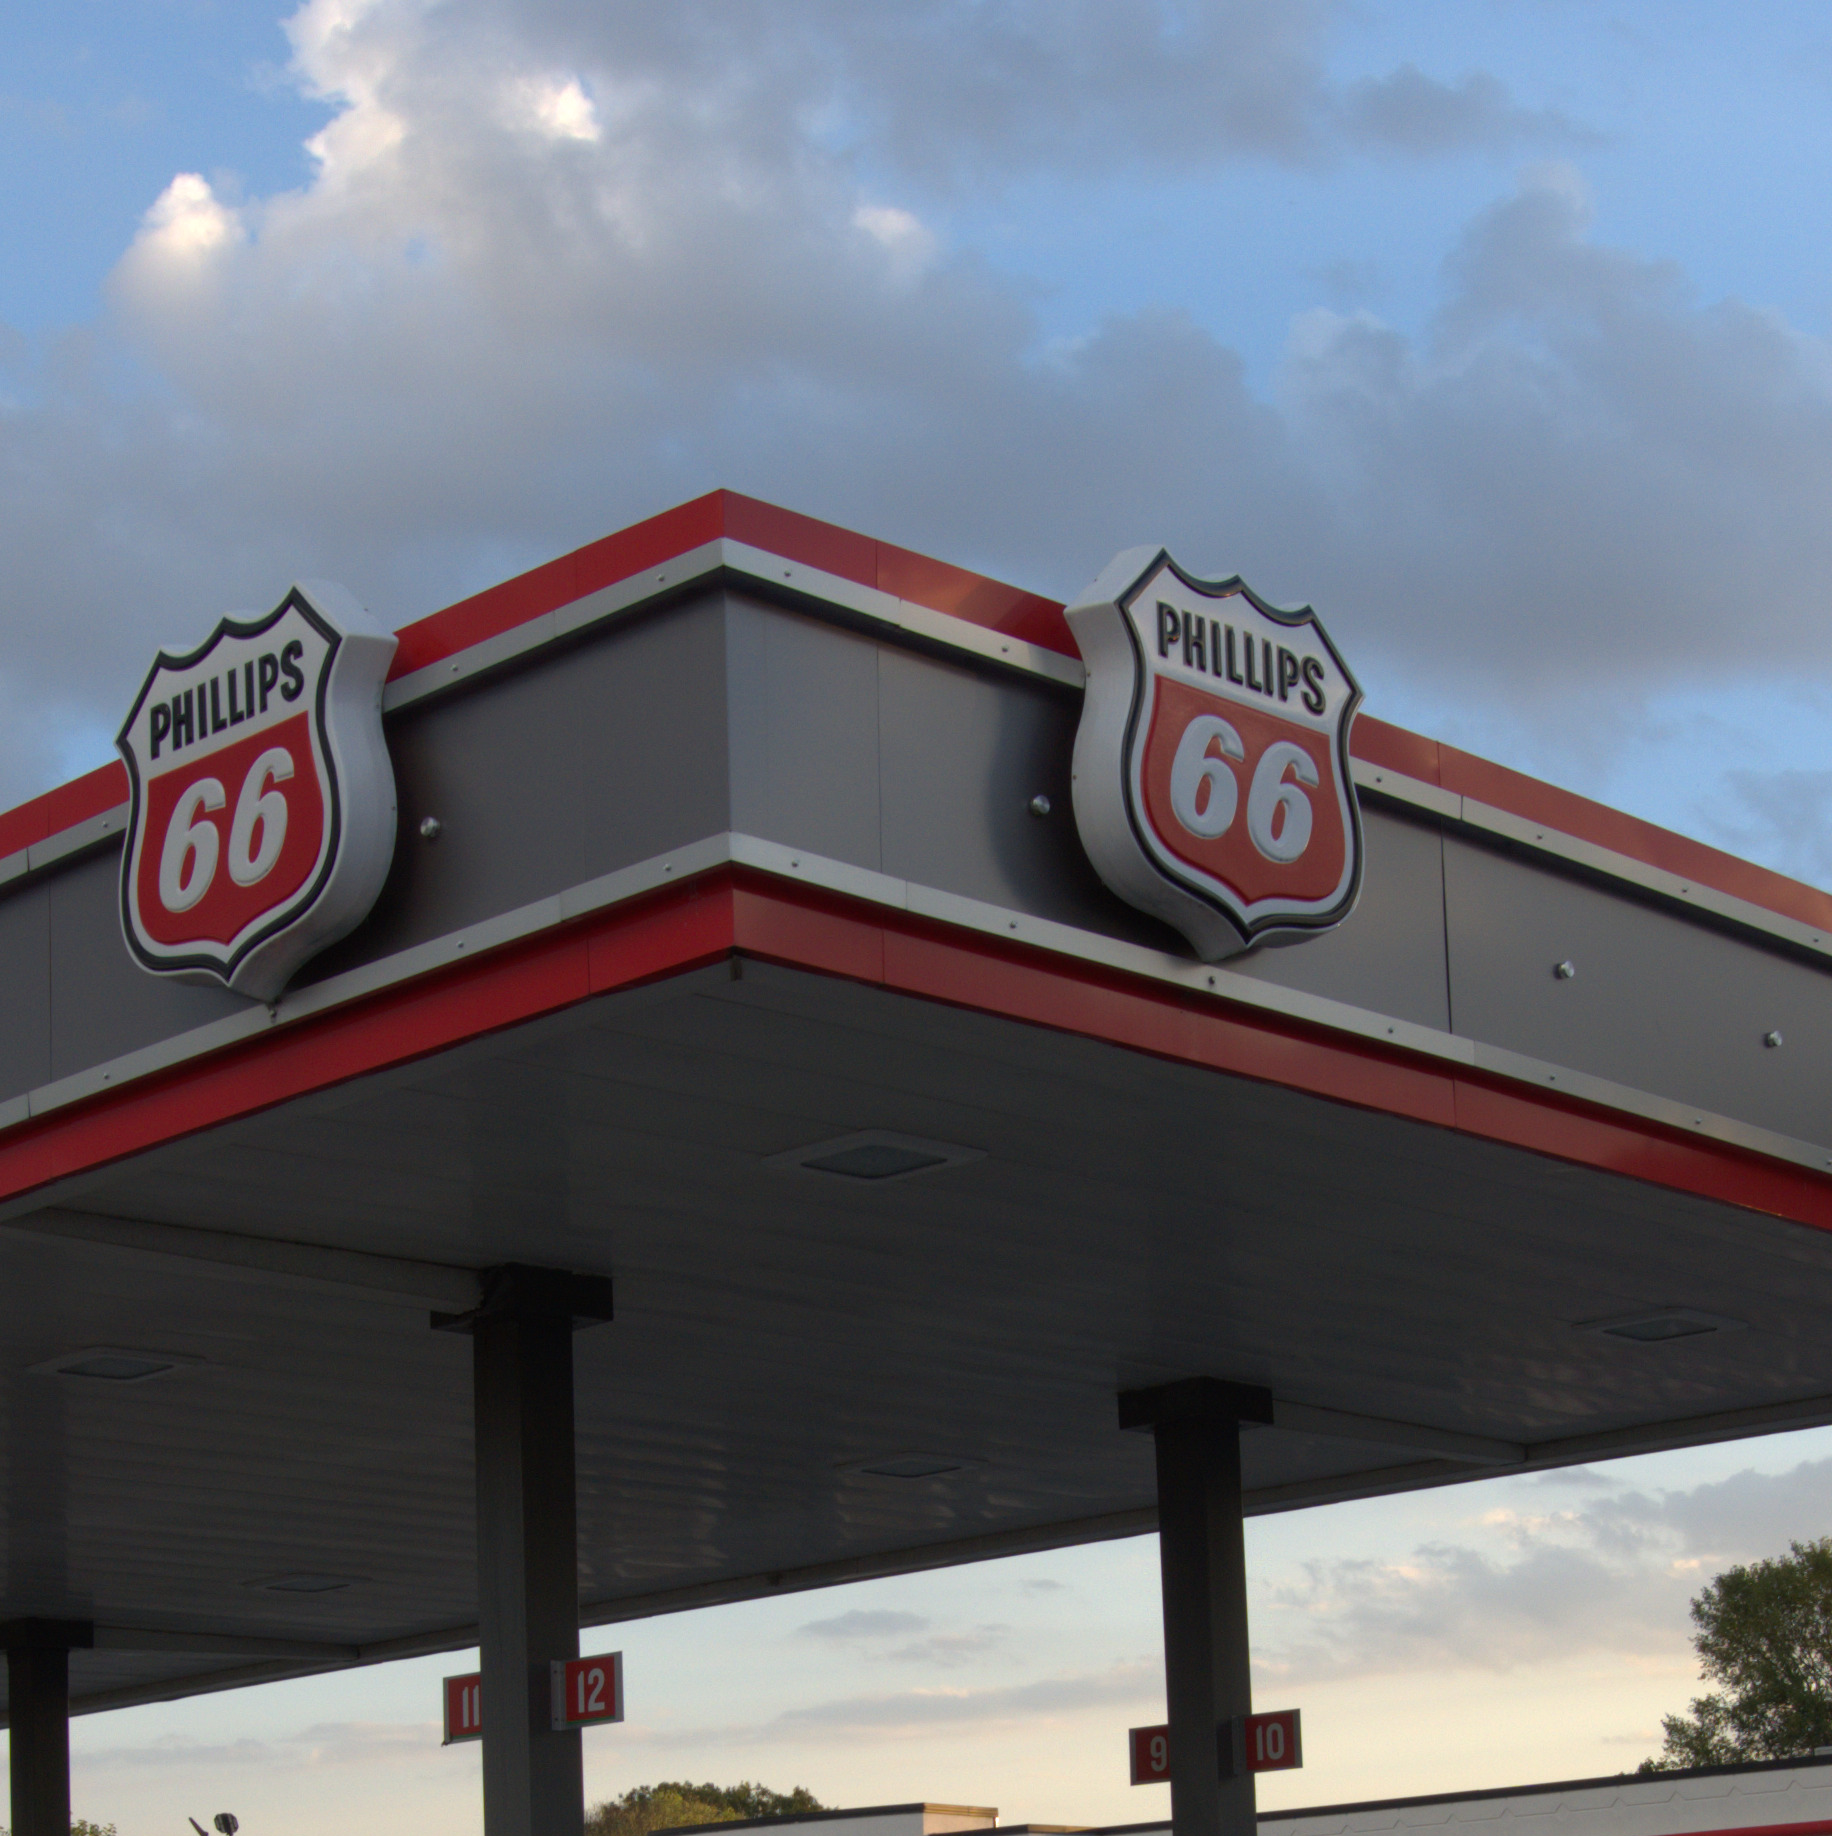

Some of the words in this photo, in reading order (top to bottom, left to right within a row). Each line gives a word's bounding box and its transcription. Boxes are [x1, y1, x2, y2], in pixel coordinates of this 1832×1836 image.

[1156, 600, 1325, 715] PHILLIPS
[150, 640, 304, 759] PHILLIPS
[1171, 714, 1319, 864] 66
[159, 747, 294, 913] 66
[462, 1685, 480, 1728] 11
[577, 1668, 605, 1713] 12
[1150, 1736, 1166, 1772] 9
[1256, 1723, 1284, 1760] 10
